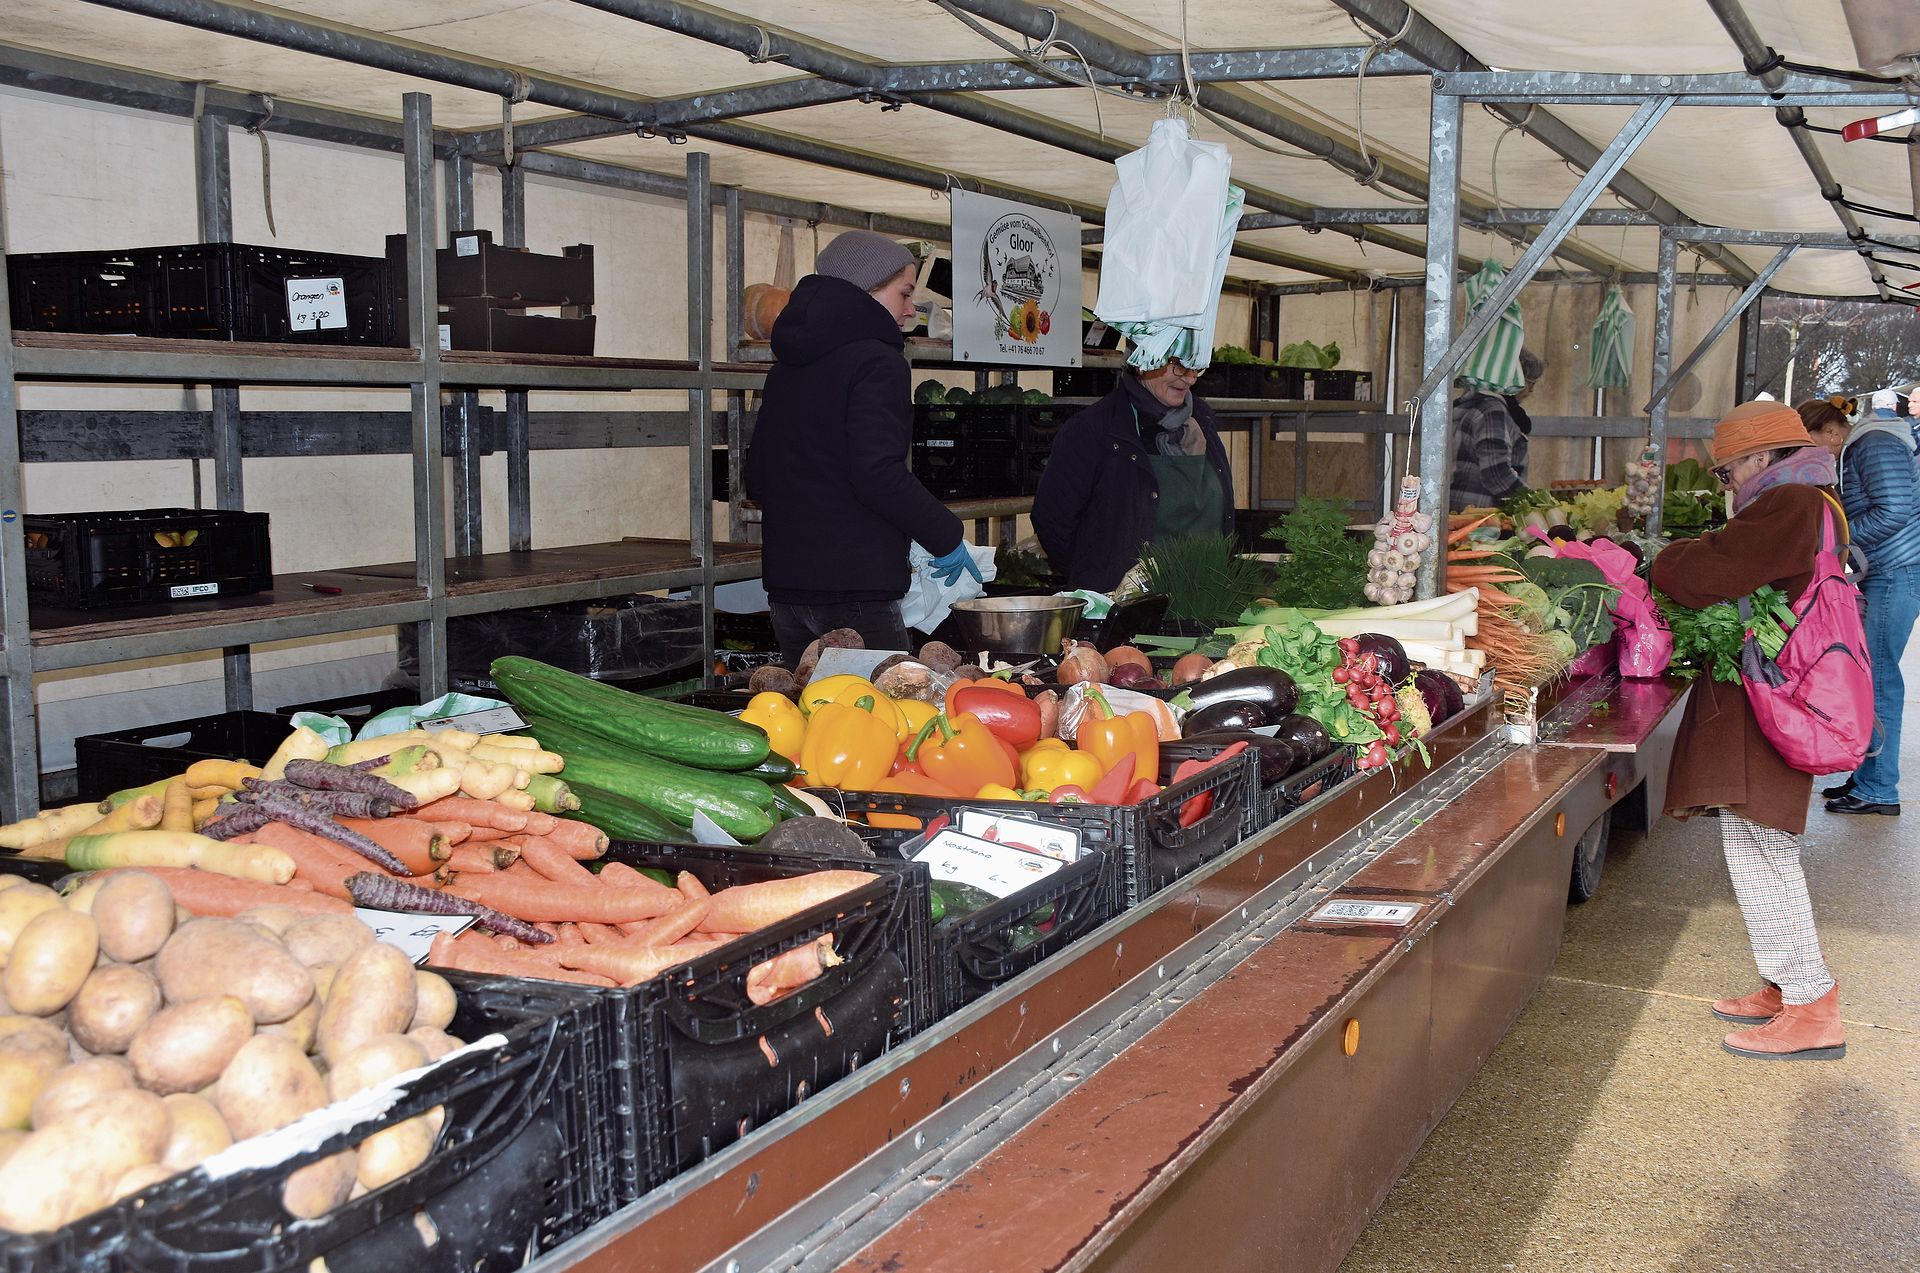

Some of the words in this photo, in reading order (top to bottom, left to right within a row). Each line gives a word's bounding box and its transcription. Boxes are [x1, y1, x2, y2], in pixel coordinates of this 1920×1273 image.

[989, 221, 1010, 244] Gemüse
[1010, 220, 1021, 228] vom
[1021, 219, 1055, 259] Schwalbenhof
[1009, 233, 1034, 253] Gloor
[292, 292, 324, 303] Orangen
[297, 313, 307, 323] kg
[311, 311, 329, 321] 3.20
[944, 840, 992, 859] Nostrano
[941, 860, 958, 875] kg
